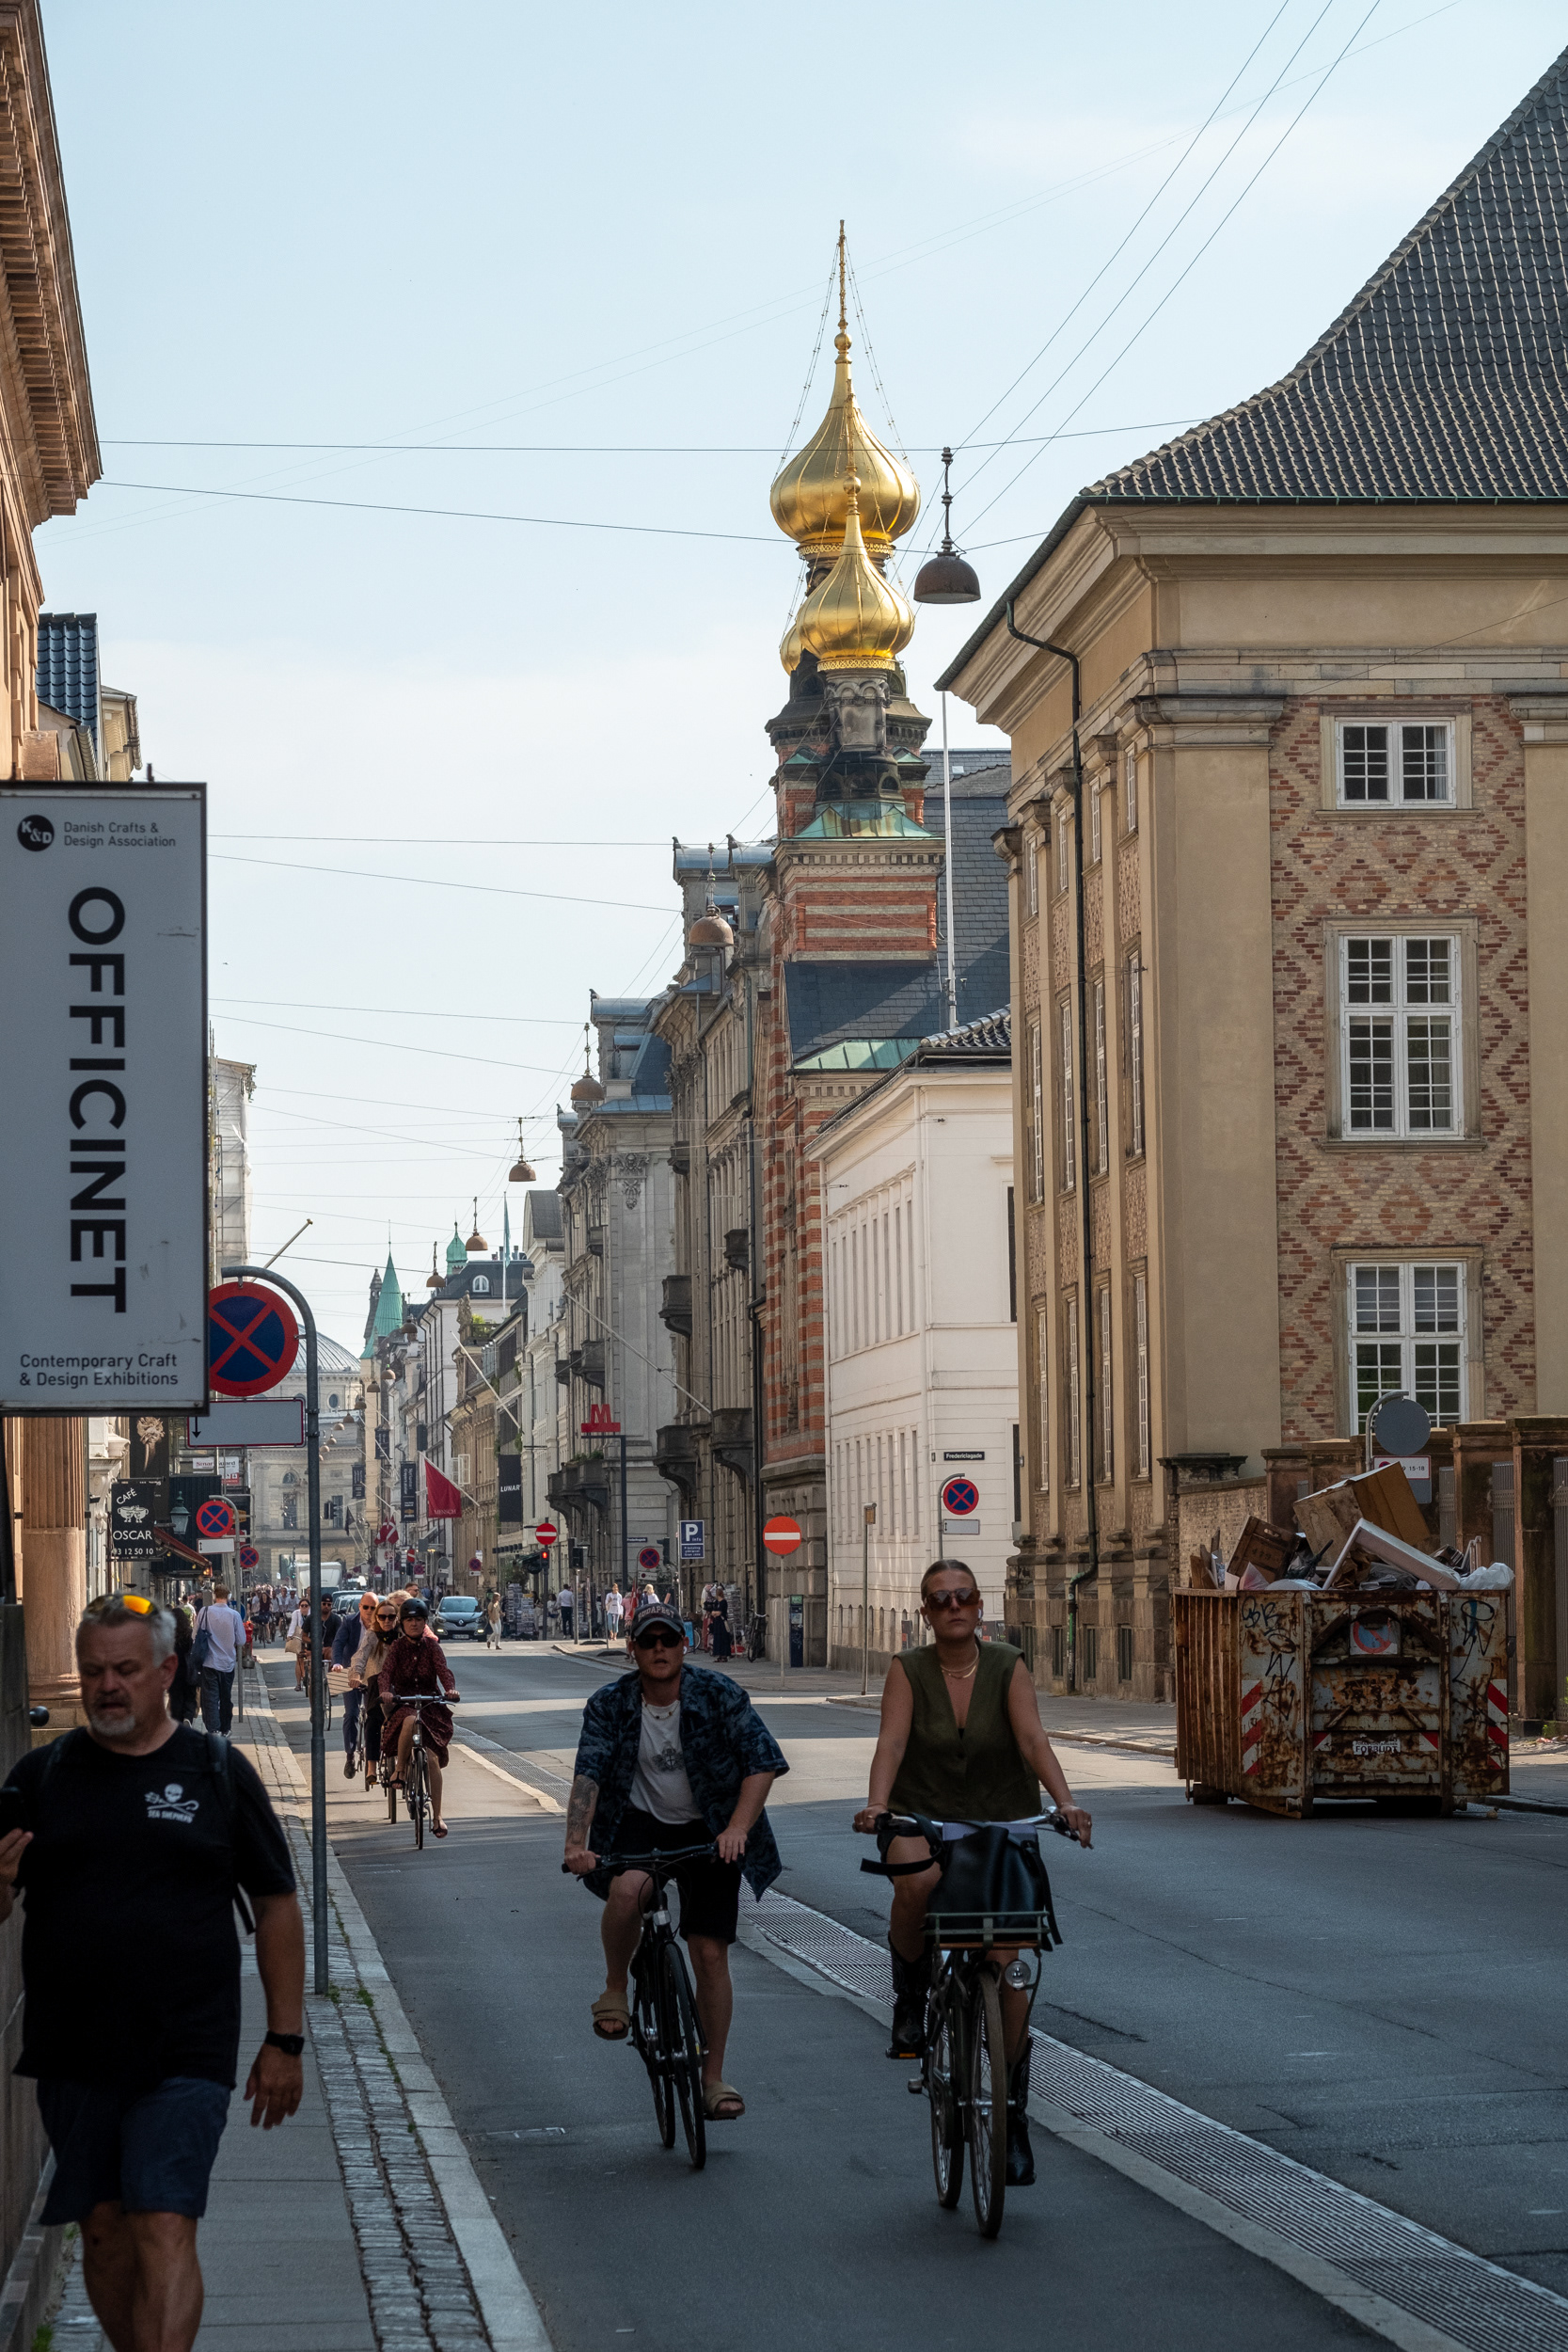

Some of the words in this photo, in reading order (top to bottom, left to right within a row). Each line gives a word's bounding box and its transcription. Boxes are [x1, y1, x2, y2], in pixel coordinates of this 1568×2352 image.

[64, 821, 104, 833] Danish
[108, 821, 146, 834] Crafts
[150, 822, 159, 833] &
[64, 834, 104, 849] Design
[108, 835, 177, 847] Association
[68, 886, 127, 1313] OFFICINET
[20, 1353, 134, 1371] Contemporary
[138, 1353, 178, 1367] Craft
[19, 1373, 31, 1386] &
[37, 1372, 88, 1390] Design
[93, 1371, 179, 1386] Exhibitions
[116, 1487, 137, 1504] CAFÉ
[500, 1484, 520, 1492] LUNAR
[113, 1530, 152, 1540] OSCAR
[685, 1523, 698, 1542] P
[638, 1605, 674, 1622] BUDAPEST
